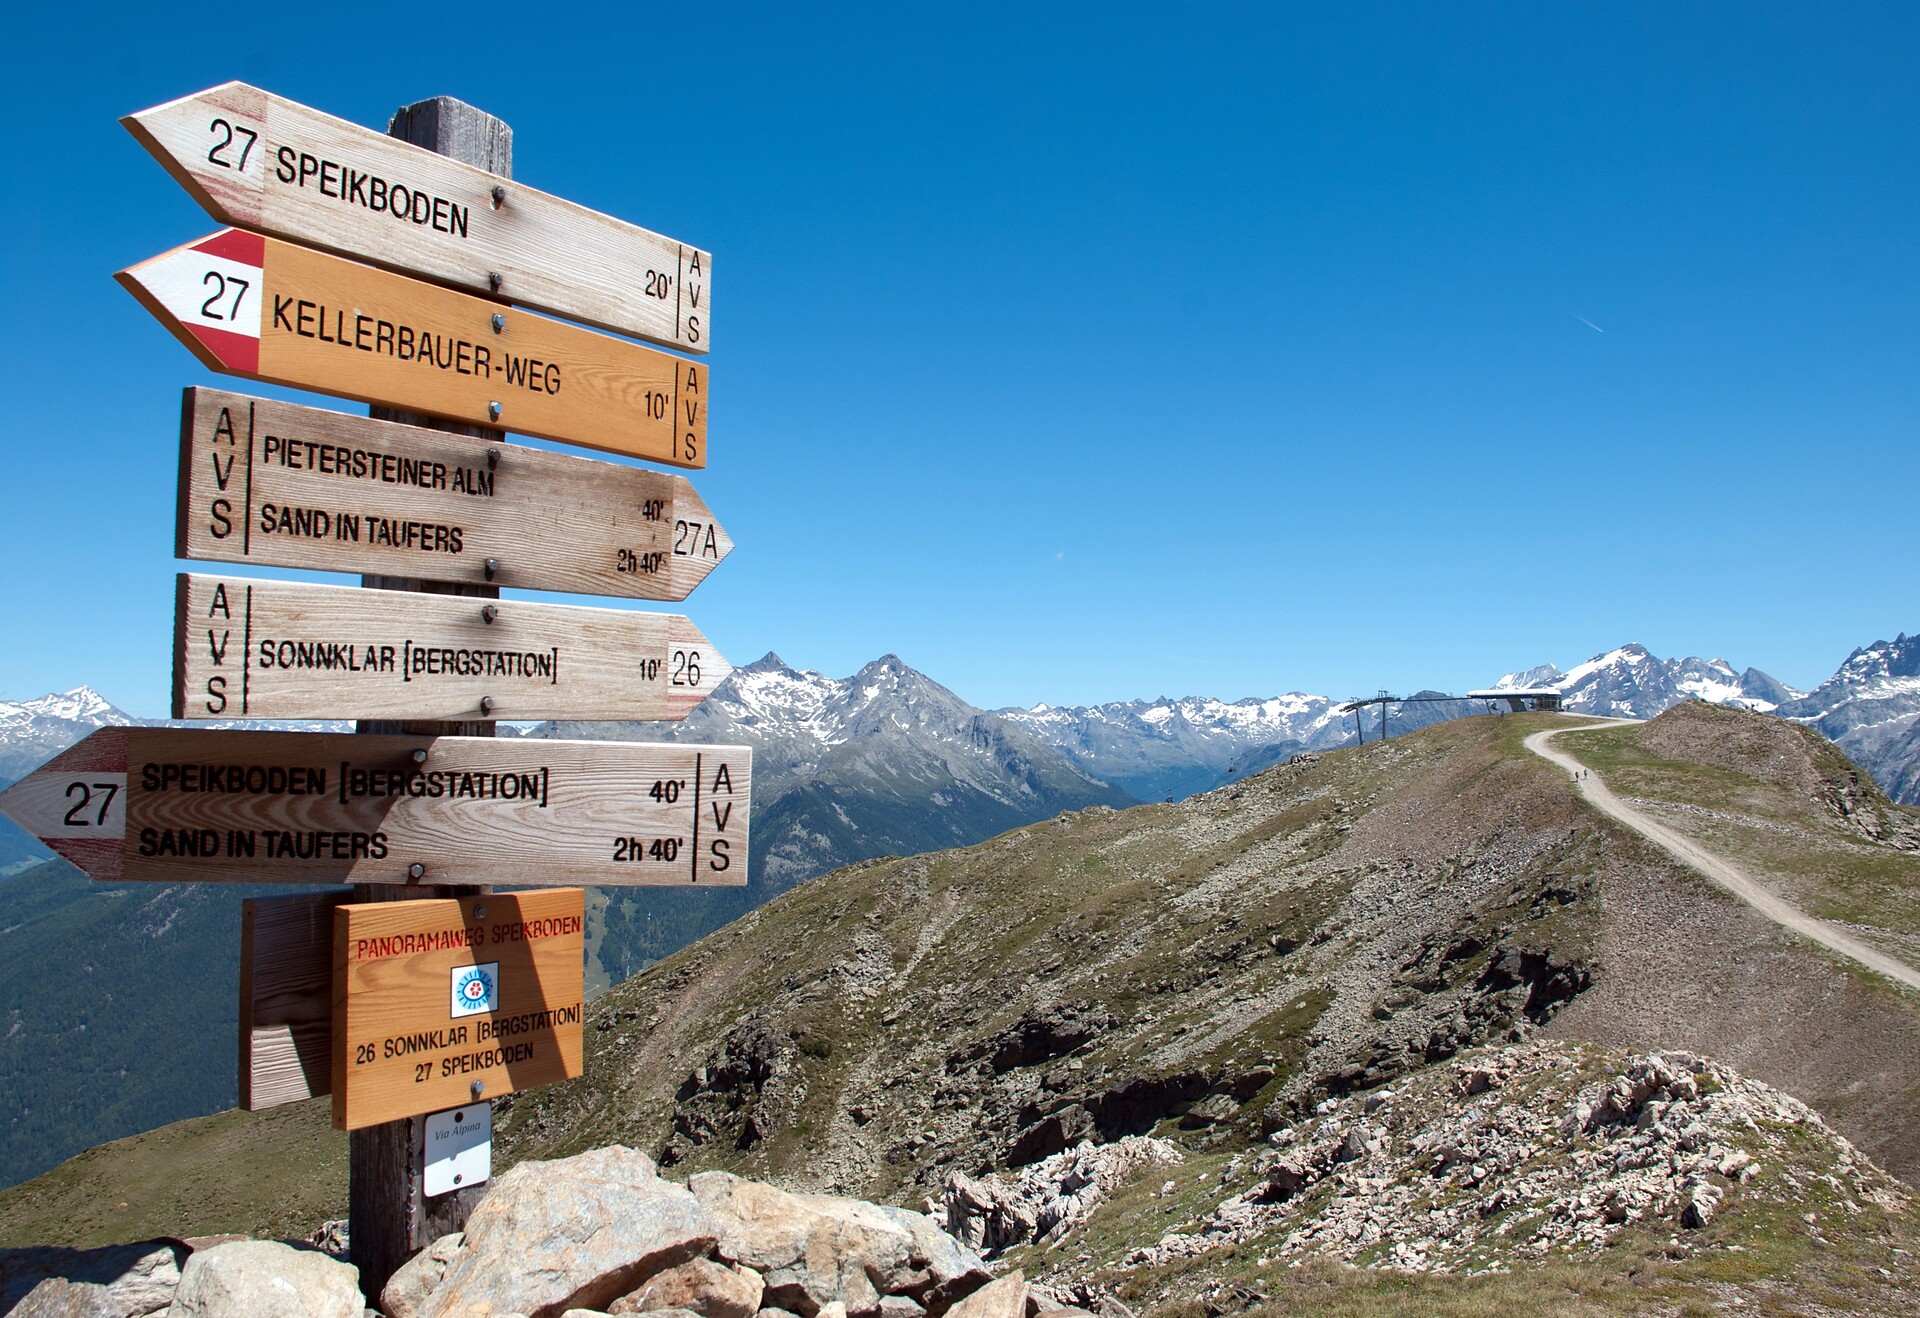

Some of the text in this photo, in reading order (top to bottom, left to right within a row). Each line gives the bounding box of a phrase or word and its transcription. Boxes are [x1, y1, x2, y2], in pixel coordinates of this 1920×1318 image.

[208, 118, 258, 172] 27
[276, 146, 468, 238] SPEIKBODEN
[201, 271, 249, 321] 27
[645, 269, 672, 300] 20'
[274, 294, 561, 395] KELLERBAUER-WEG
[645, 391, 669, 420] 10'
[264, 436, 494, 497] PIETERSTEINER ALM
[261, 505, 463, 553] SAND IN TAUFERS
[642, 500, 664, 521] 40'
[675, 519, 718, 559] 27A
[617, 549, 663, 574] 2h 40'
[259, 640, 558, 685] SONNKLAR [BERGSTATION]
[640, 659, 661, 682] 10'
[673, 651, 701, 686] 26
[142, 761, 549, 807] SPEIKBODEN [BERGSTATION]
[649, 779, 686, 804] 40'
[64, 782, 118, 827] 27
[139, 828, 388, 860] SAND IN TAUFERS
[613, 836, 684, 862] 2h 40'
[357, 916, 581, 960] PANORAMAWEG SPEIKBODEN
[356, 1003, 580, 1065] 26 SONNKLAR [BERGSTATION]
[415, 1043, 534, 1083] 27 SPEIKBODEN
[435, 1122, 481, 1141] Via Alpina
